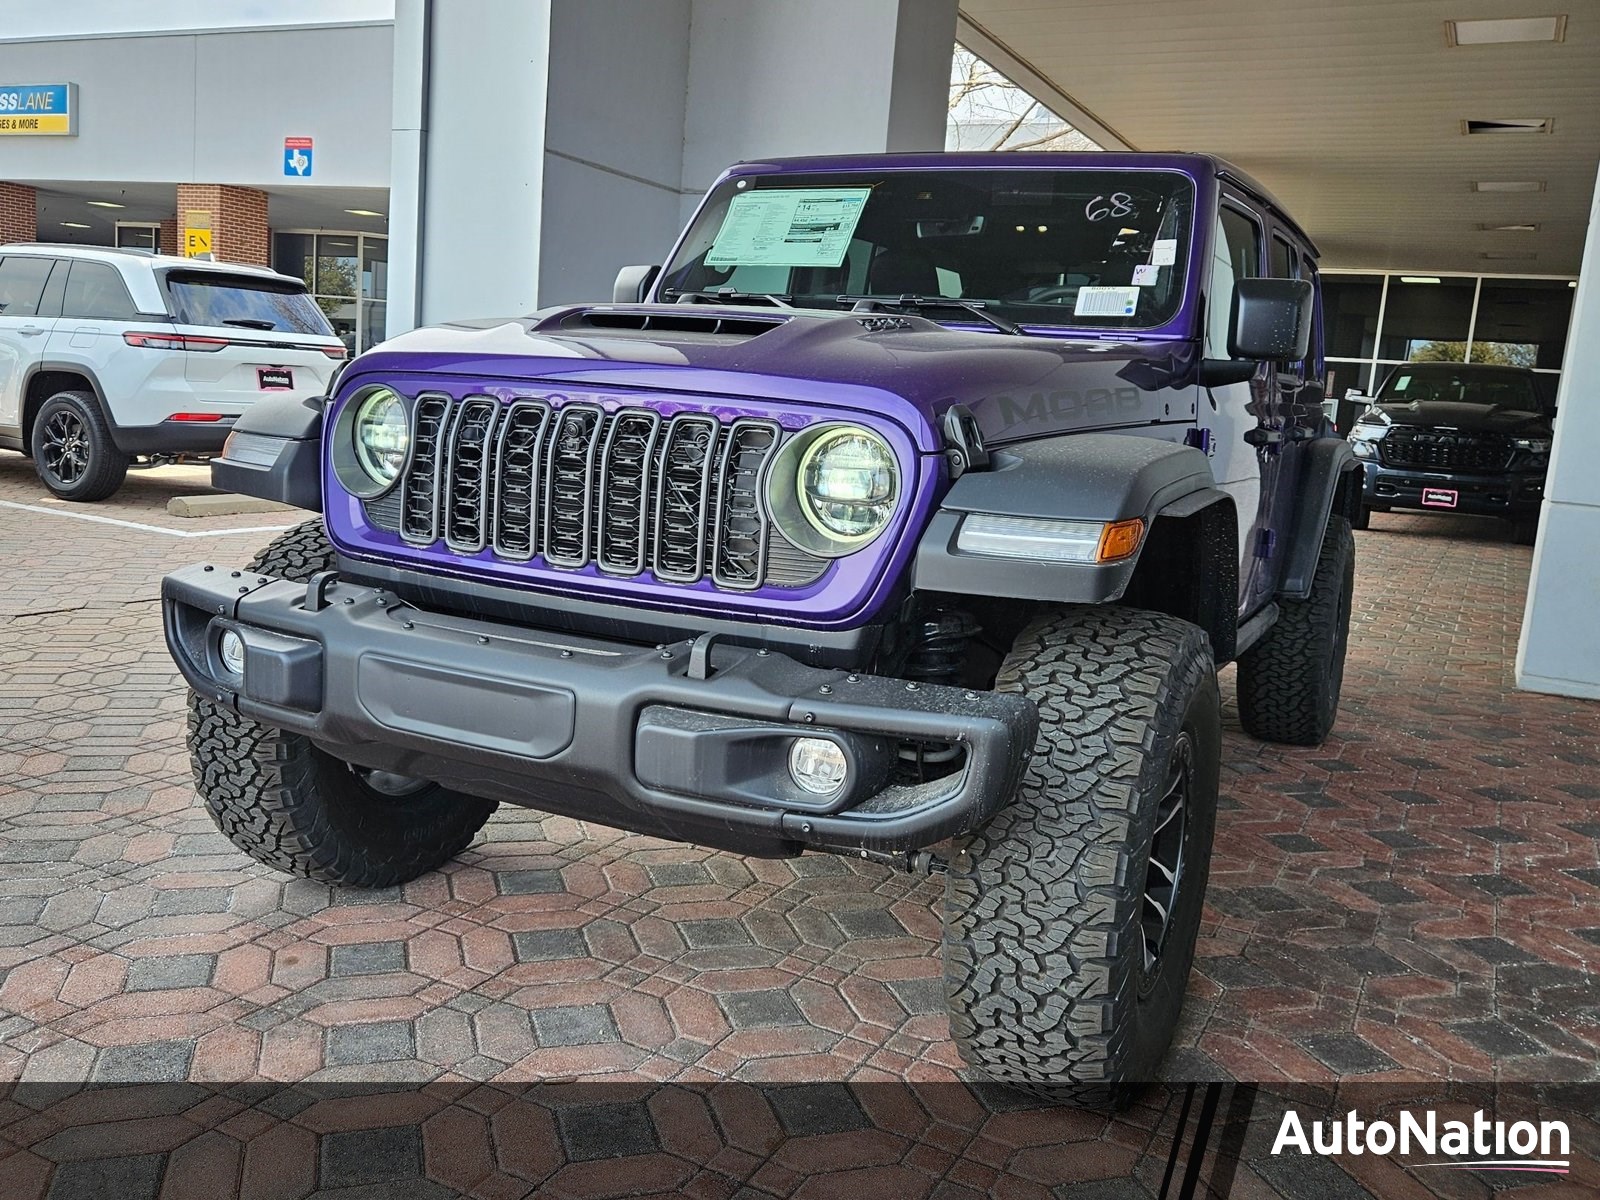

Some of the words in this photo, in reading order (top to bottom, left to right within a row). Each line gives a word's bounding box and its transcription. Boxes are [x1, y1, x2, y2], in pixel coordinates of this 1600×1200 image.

[11, 119, 17, 130] &
[18, 118, 39, 129] MORE
[1085, 192, 1132, 222] 68
[998, 387, 1142, 424] MOAB
